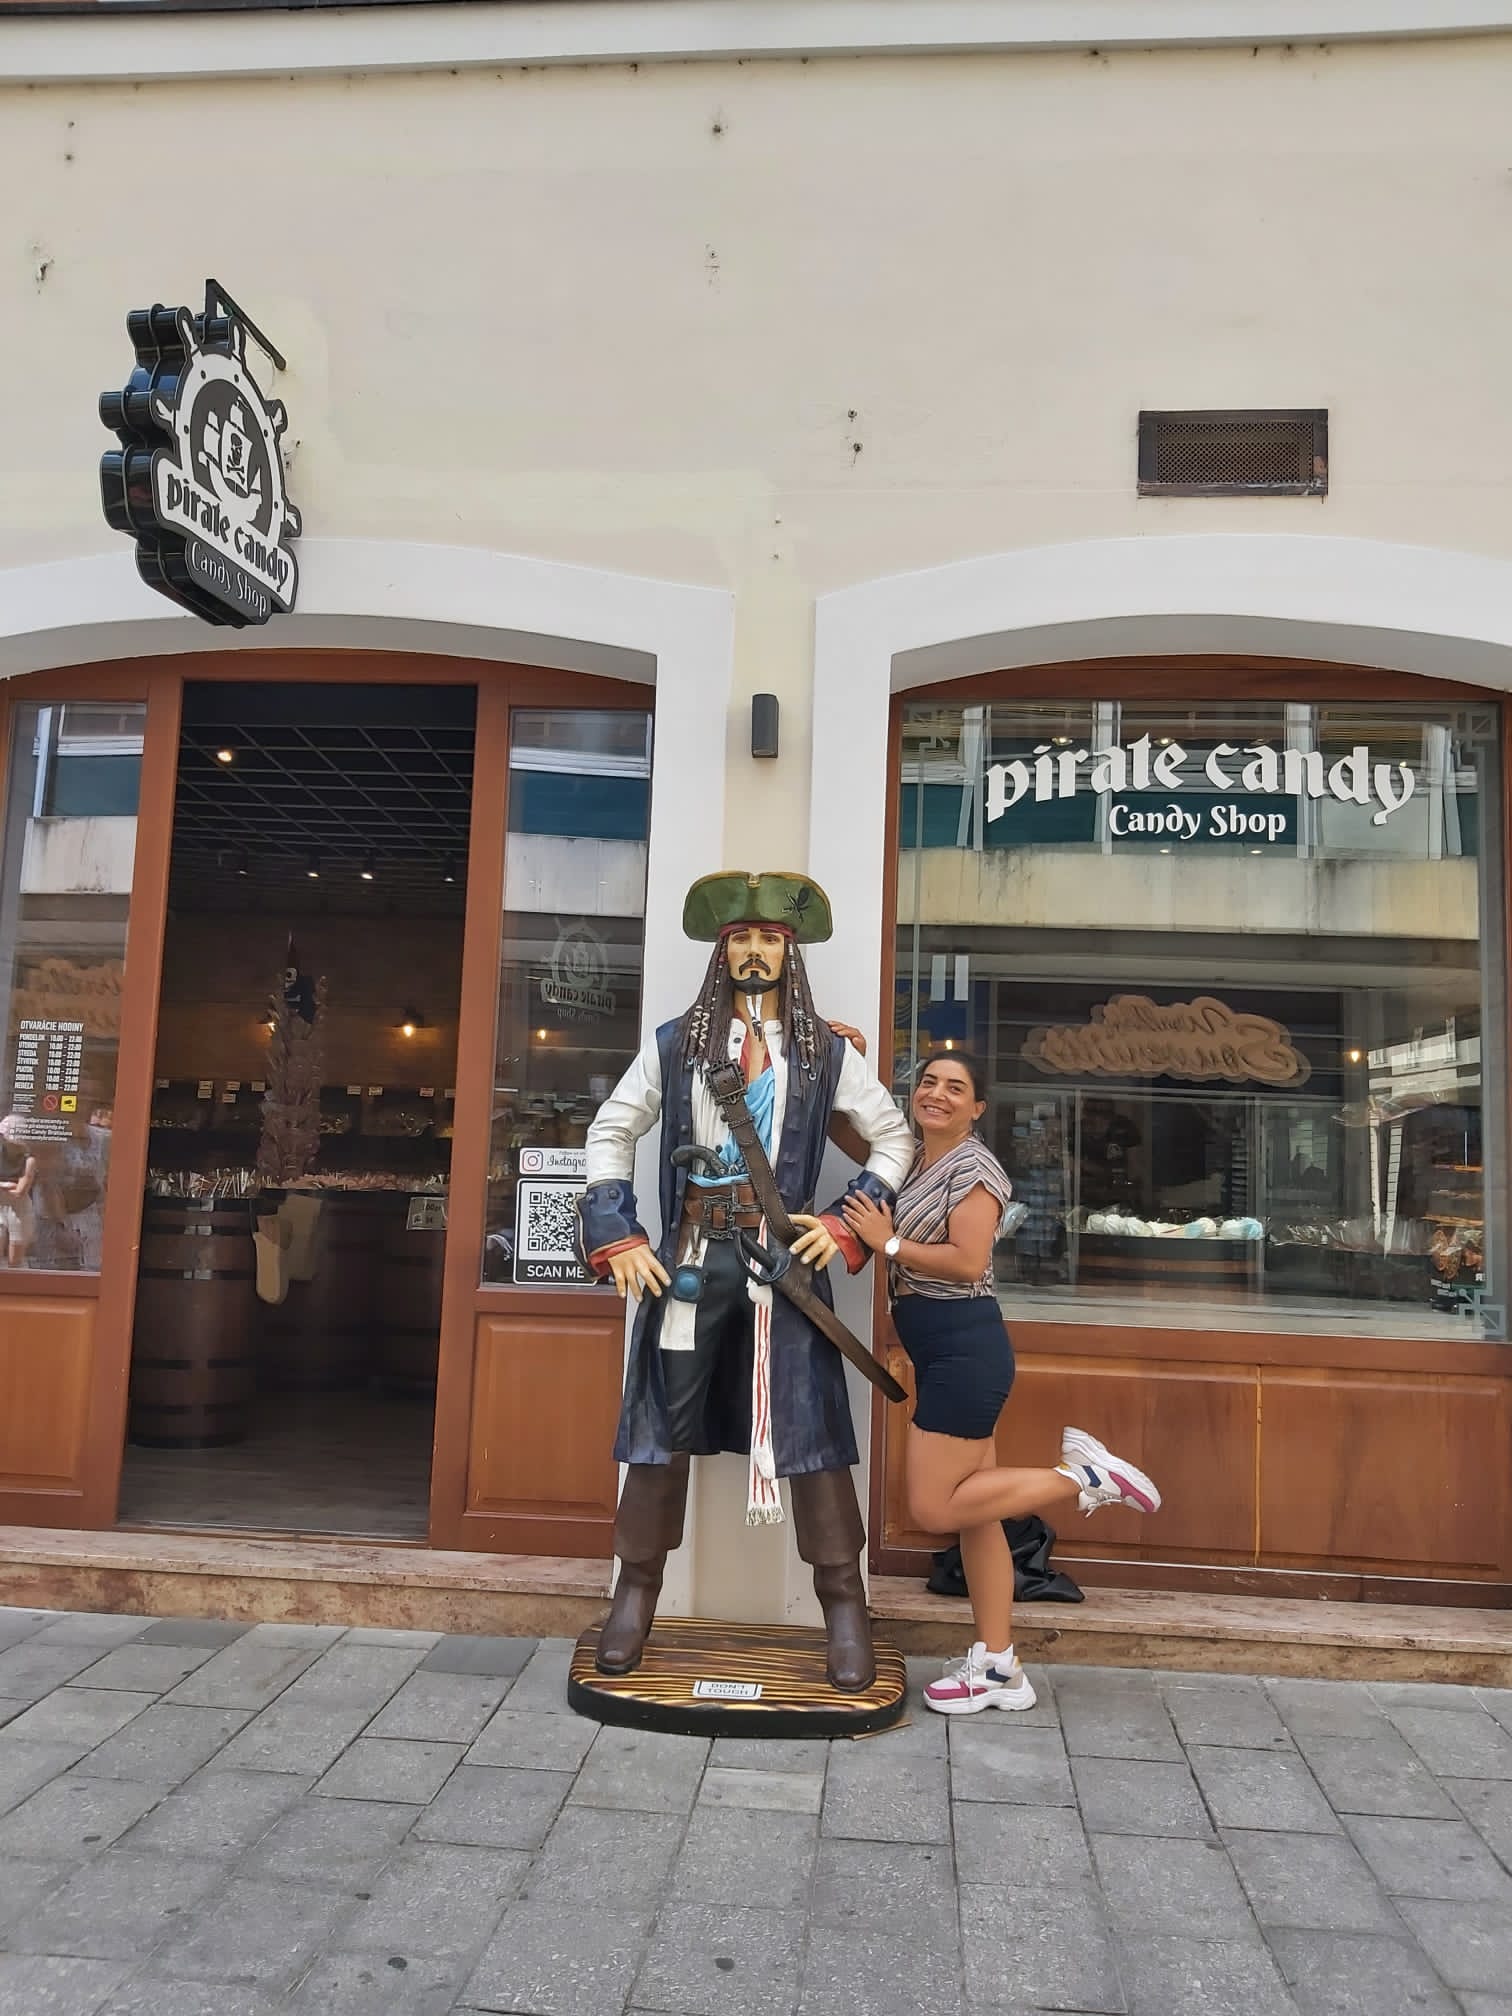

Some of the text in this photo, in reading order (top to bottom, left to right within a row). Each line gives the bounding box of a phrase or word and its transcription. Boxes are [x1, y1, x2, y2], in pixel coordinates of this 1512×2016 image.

[233, 526, 289, 592] candy
[191, 541, 267, 617] Candy Shop
[985, 732, 1416, 826] pirate candy
[1108, 804, 1286, 841] Candy Shop
[58, 1022, 83, 1032] HODINY
[547, 1154, 587, 1173] Instagra
[527, 1265, 584, 1279] SCAN ME
